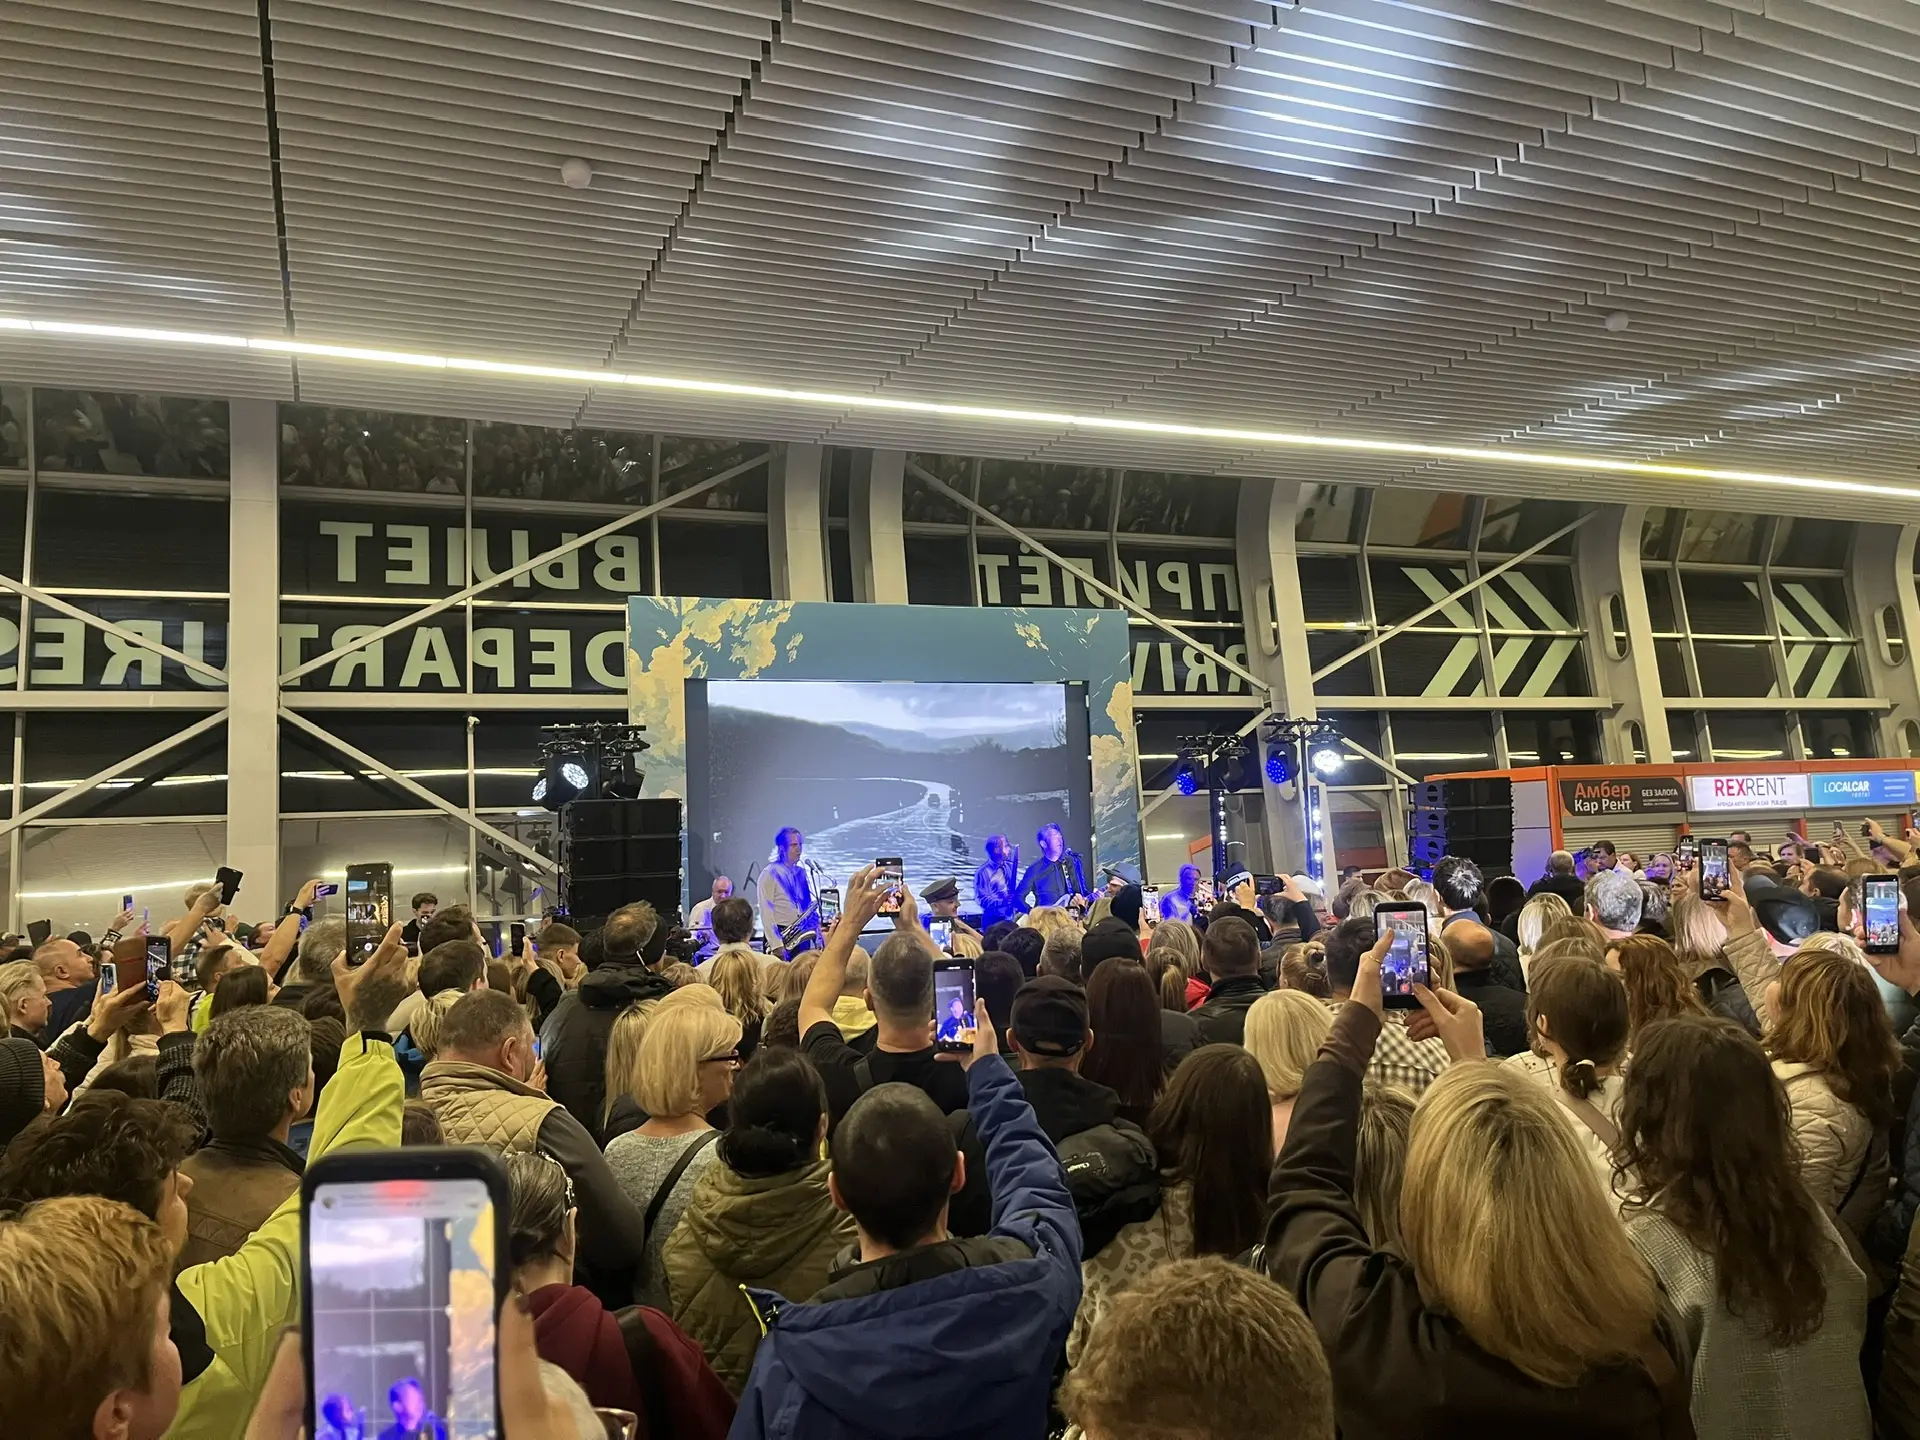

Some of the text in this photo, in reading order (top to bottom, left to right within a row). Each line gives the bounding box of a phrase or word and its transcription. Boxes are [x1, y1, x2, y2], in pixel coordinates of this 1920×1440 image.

[1574, 780, 1631, 801] Амбер
[1641, 788, 1679, 797] БЕЗ ЗАЛОГА
[1714, 777, 1787, 797] REXRENT
[1823, 781, 1870, 793] LOCALCAR
[1574, 798, 1631, 813] Кар Рент
